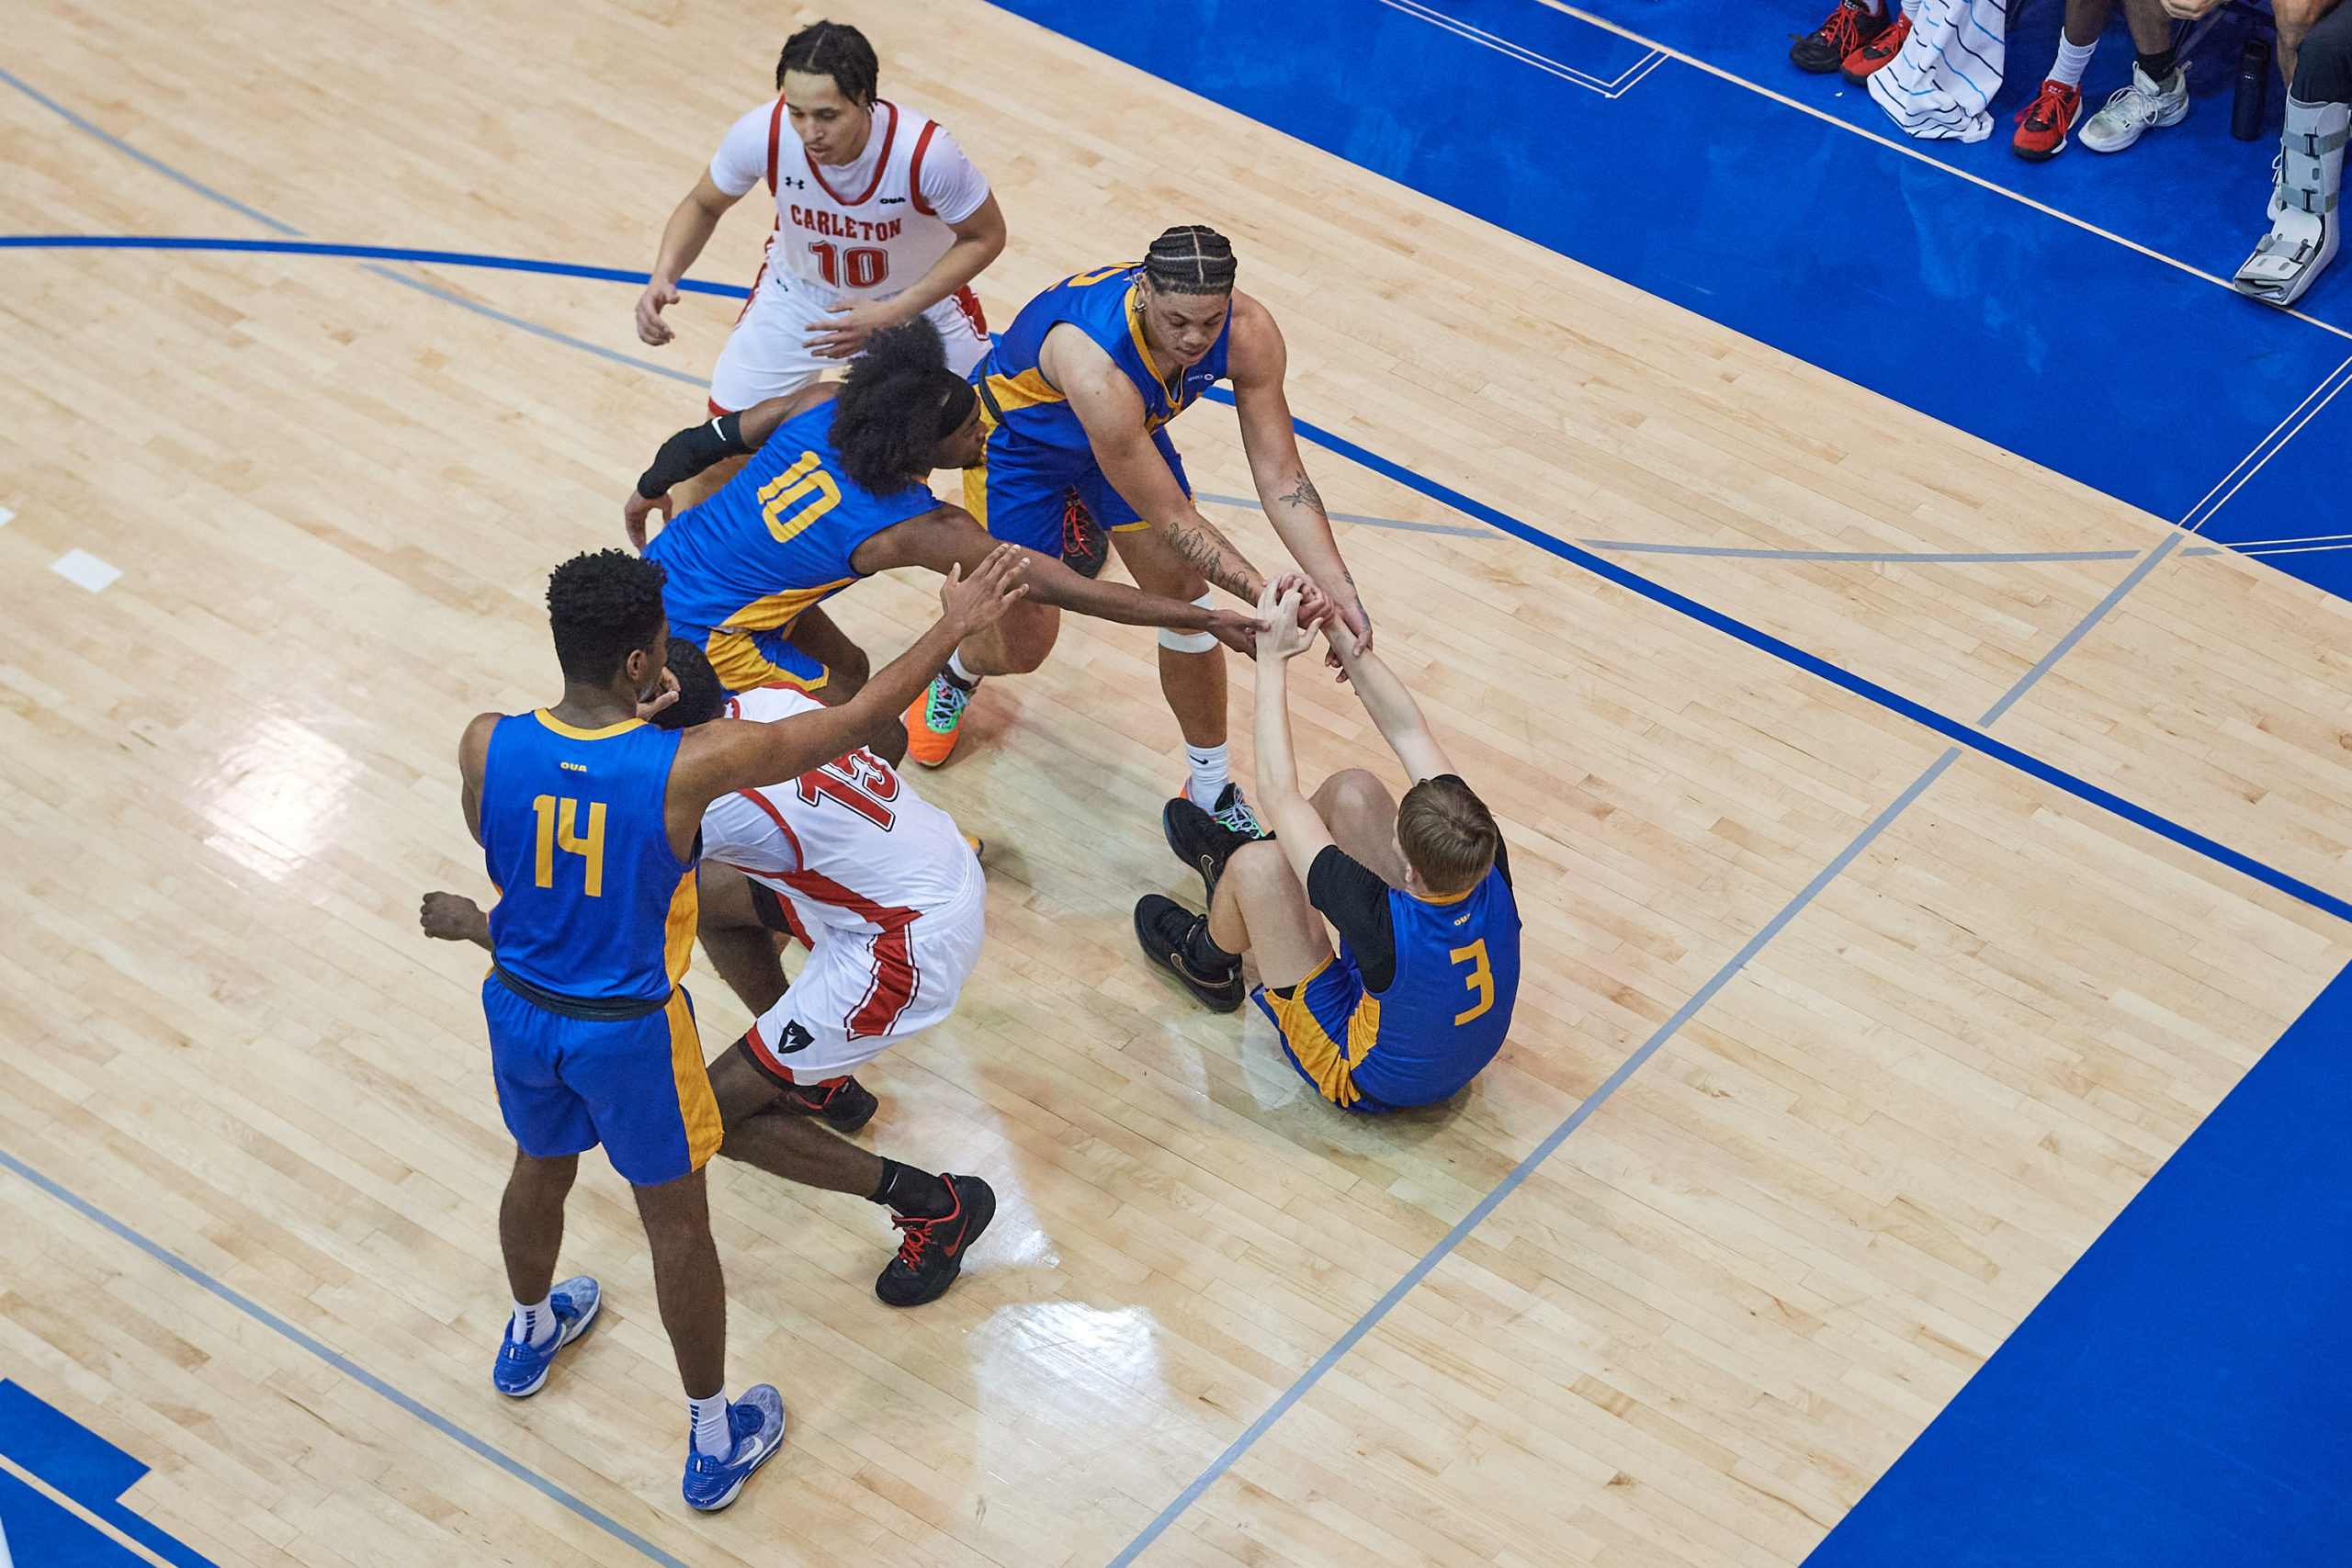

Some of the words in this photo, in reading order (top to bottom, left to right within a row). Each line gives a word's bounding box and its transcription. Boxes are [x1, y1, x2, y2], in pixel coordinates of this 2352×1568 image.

[790, 204, 901, 242] CARLETON
[808, 240, 889, 289] 10
[756, 450, 842, 544] 10
[560, 761, 588, 773] OUA
[532, 794, 607, 897] 14
[1449, 937, 1496, 1027] 3
